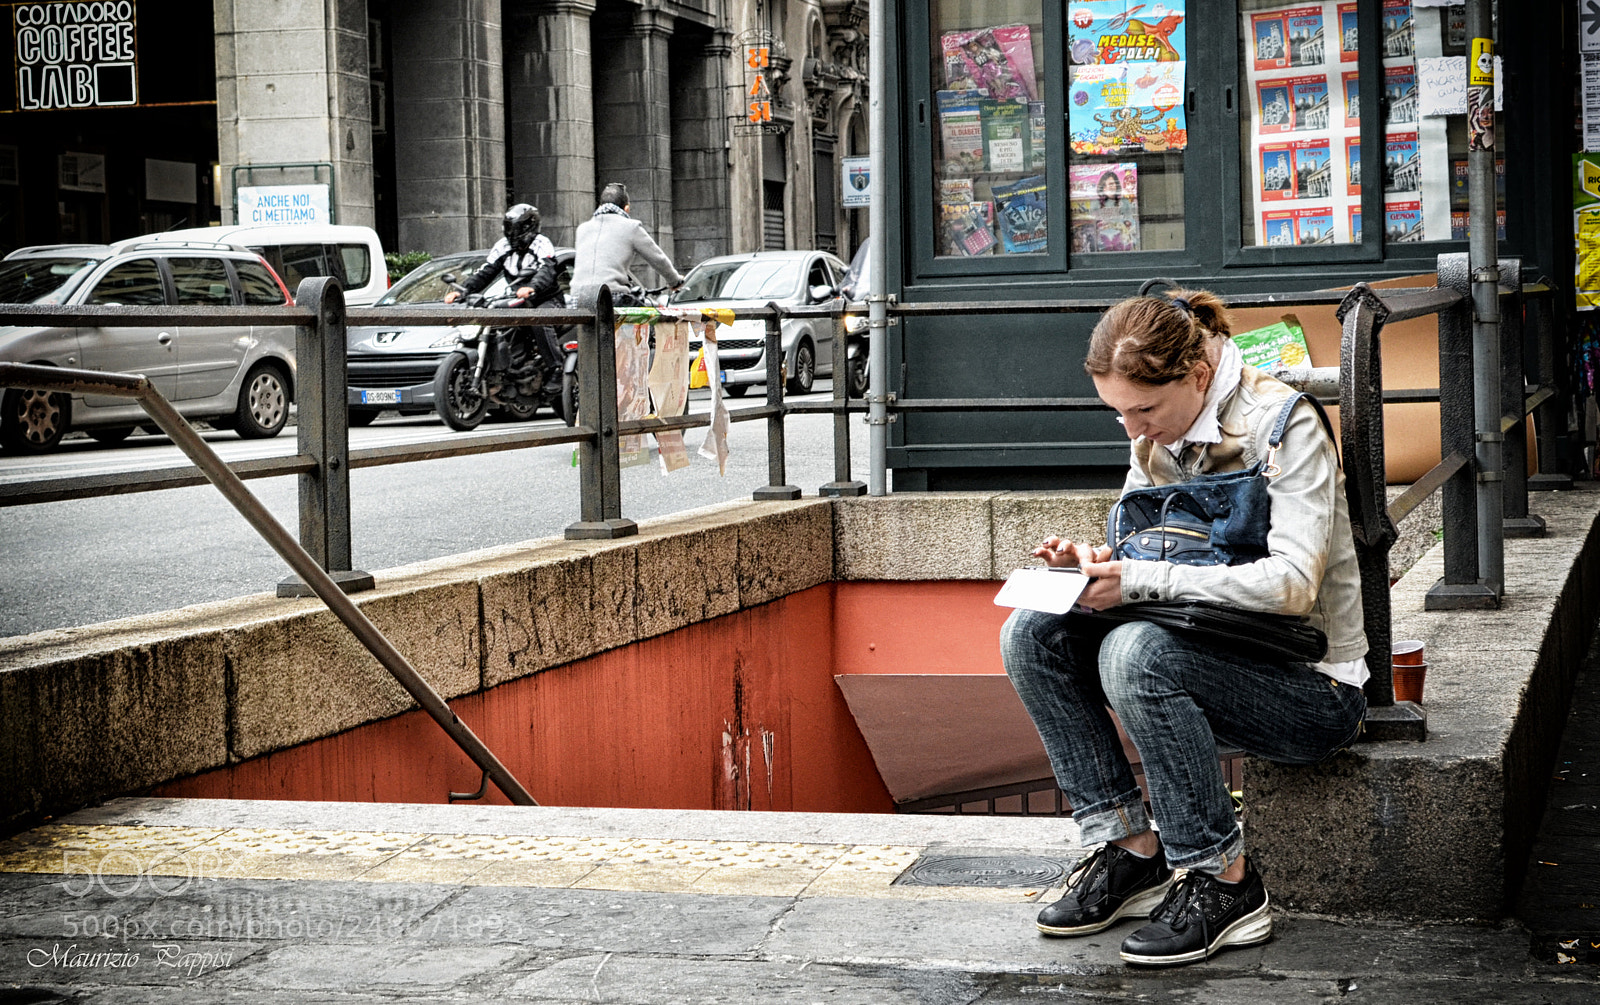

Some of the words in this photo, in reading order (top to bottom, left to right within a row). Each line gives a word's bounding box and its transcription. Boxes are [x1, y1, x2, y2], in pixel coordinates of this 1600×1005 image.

[16, 1, 132, 26] COSTADORO
[18, 22, 135, 65] COFFEE
[1098, 35, 1155, 47] MEDUSE
[1117, 47, 1161, 60] POLPI
[19, 64, 94, 109] LAB
[1427, 73, 1467, 89] RICARIC
[257, 195, 290, 208] ANCHE
[293, 194, 310, 207] NOI
[252, 209, 262, 222] CI
[265, 208, 315, 222] METTIAMO
